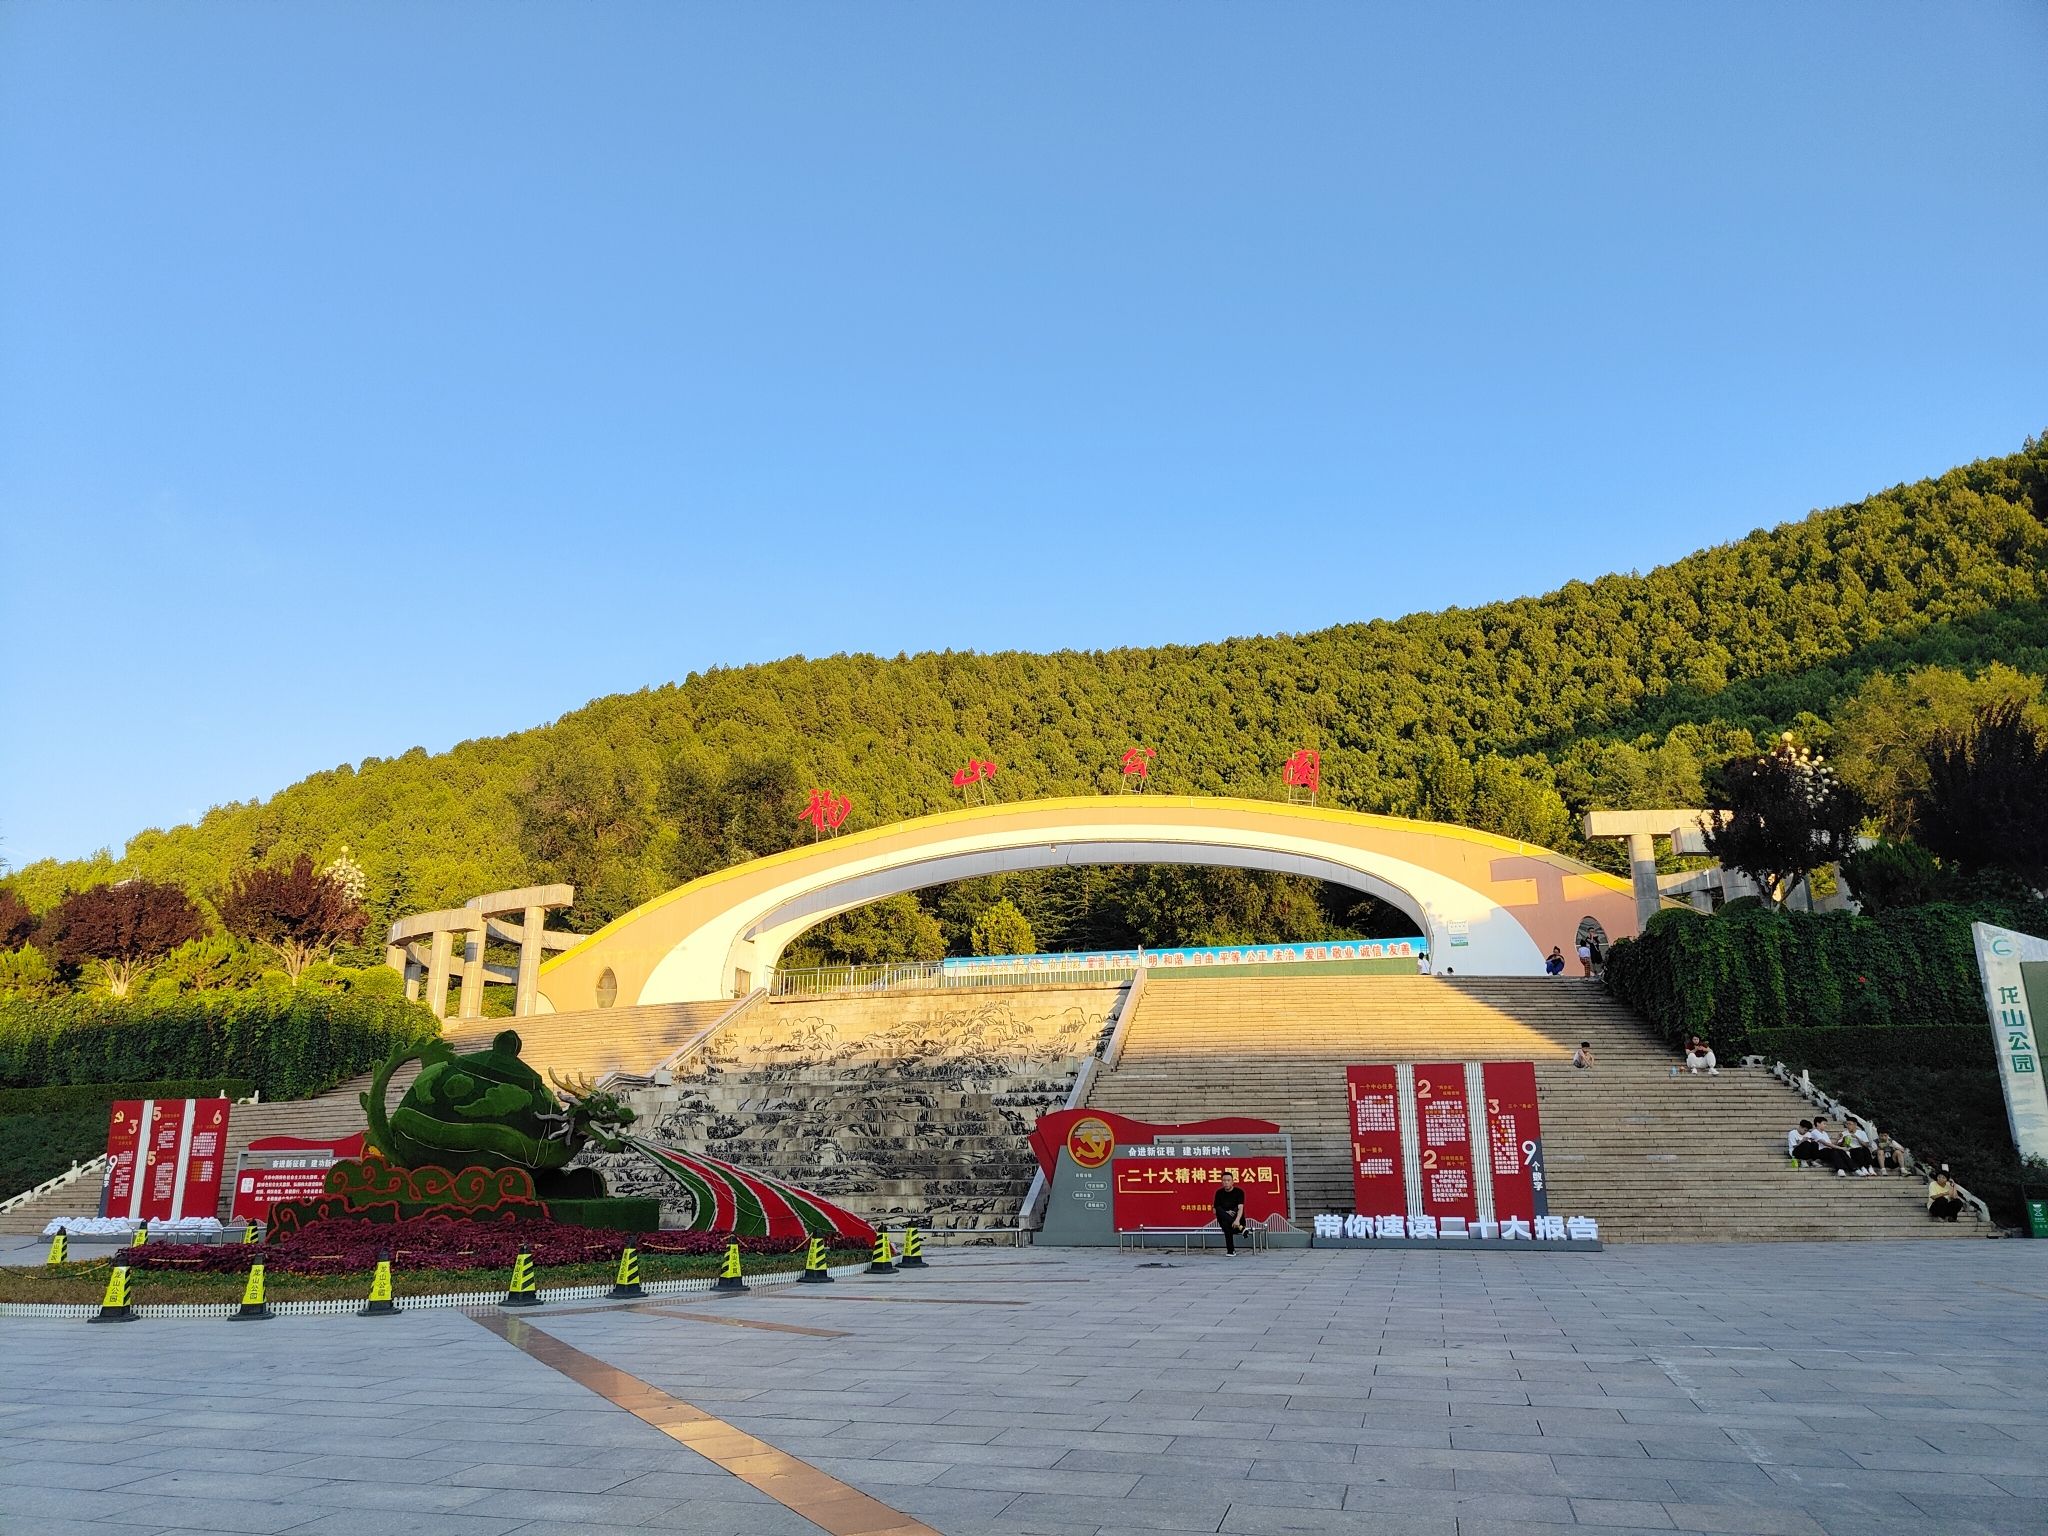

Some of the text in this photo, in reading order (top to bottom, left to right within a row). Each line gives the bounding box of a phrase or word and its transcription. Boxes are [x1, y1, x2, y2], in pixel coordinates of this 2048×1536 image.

[1162, 953, 1184, 965] 和谐
[1194, 952, 1215, 964] 自由
[1220, 951, 1241, 963] 平等
[1247, 950, 1267, 962] 公正
[1274, 948, 1295, 961] 法治
[1304, 947, 1327, 960] 爱国
[1332, 946, 1354, 959] 敬业
[1360, 944, 1382, 957] 诚信
[1388, 942, 1411, 956] 友善
[1998, 986, 2036, 1073] 龙山公园
[1349, 1083, 1357, 1101] 1
[1417, 1079, 1431, 1098] 2
[153, 1106, 162, 1121] 5
[1488, 1098, 1500, 1114] 3
[213, 1109, 222, 1124] 6
[128, 1119, 138, 1134] 3
[147, 1150, 157, 1166] 5
[1128, 1146, 1231, 1157] 奋进新征程 建功新时代
[1353, 1142, 1361, 1161] 1
[1423, 1150, 1437, 1169] 2
[109, 1155, 118, 1173] 9
[272, 1159, 339, 1168] 奋进新征程 建功新时
[1522, 1140, 1544, 1191] 9 个数字
[1127, 1166, 1273, 1184] 二十大精神主题公园
[1314, 1214, 1599, 1241] 带你速读二十大报告
[109, 1272, 122, 1303] 龙山公园
[249, 1268, 261, 1299] 龙山公园
[378, 1266, 387, 1297] 龙山公园
